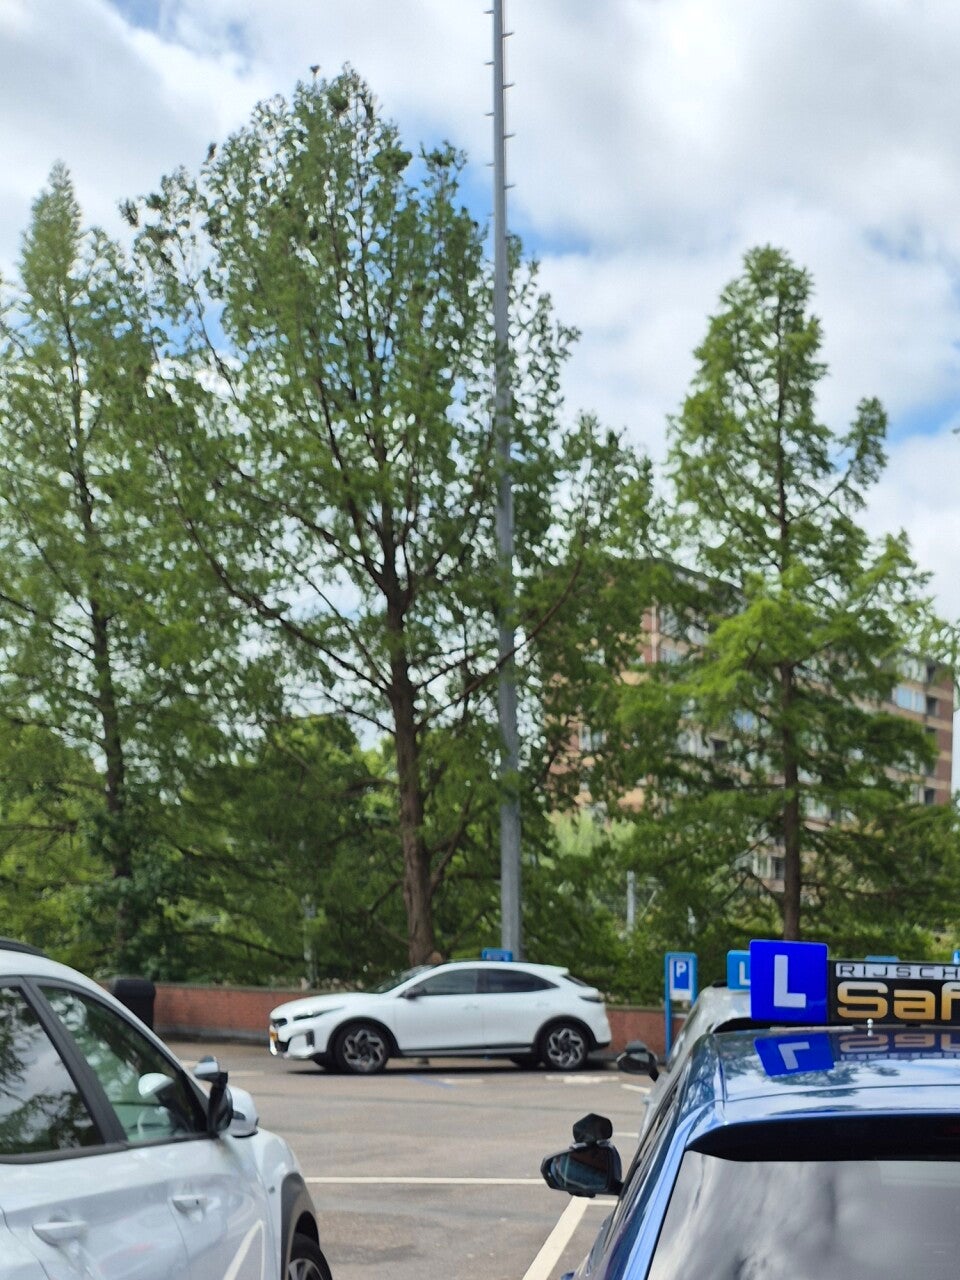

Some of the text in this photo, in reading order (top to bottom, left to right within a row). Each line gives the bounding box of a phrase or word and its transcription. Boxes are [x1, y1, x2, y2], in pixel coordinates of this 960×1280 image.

[676, 961, 687, 978] P
[739, 961, 751, 986] L
[774, 954, 807, 1008] L
